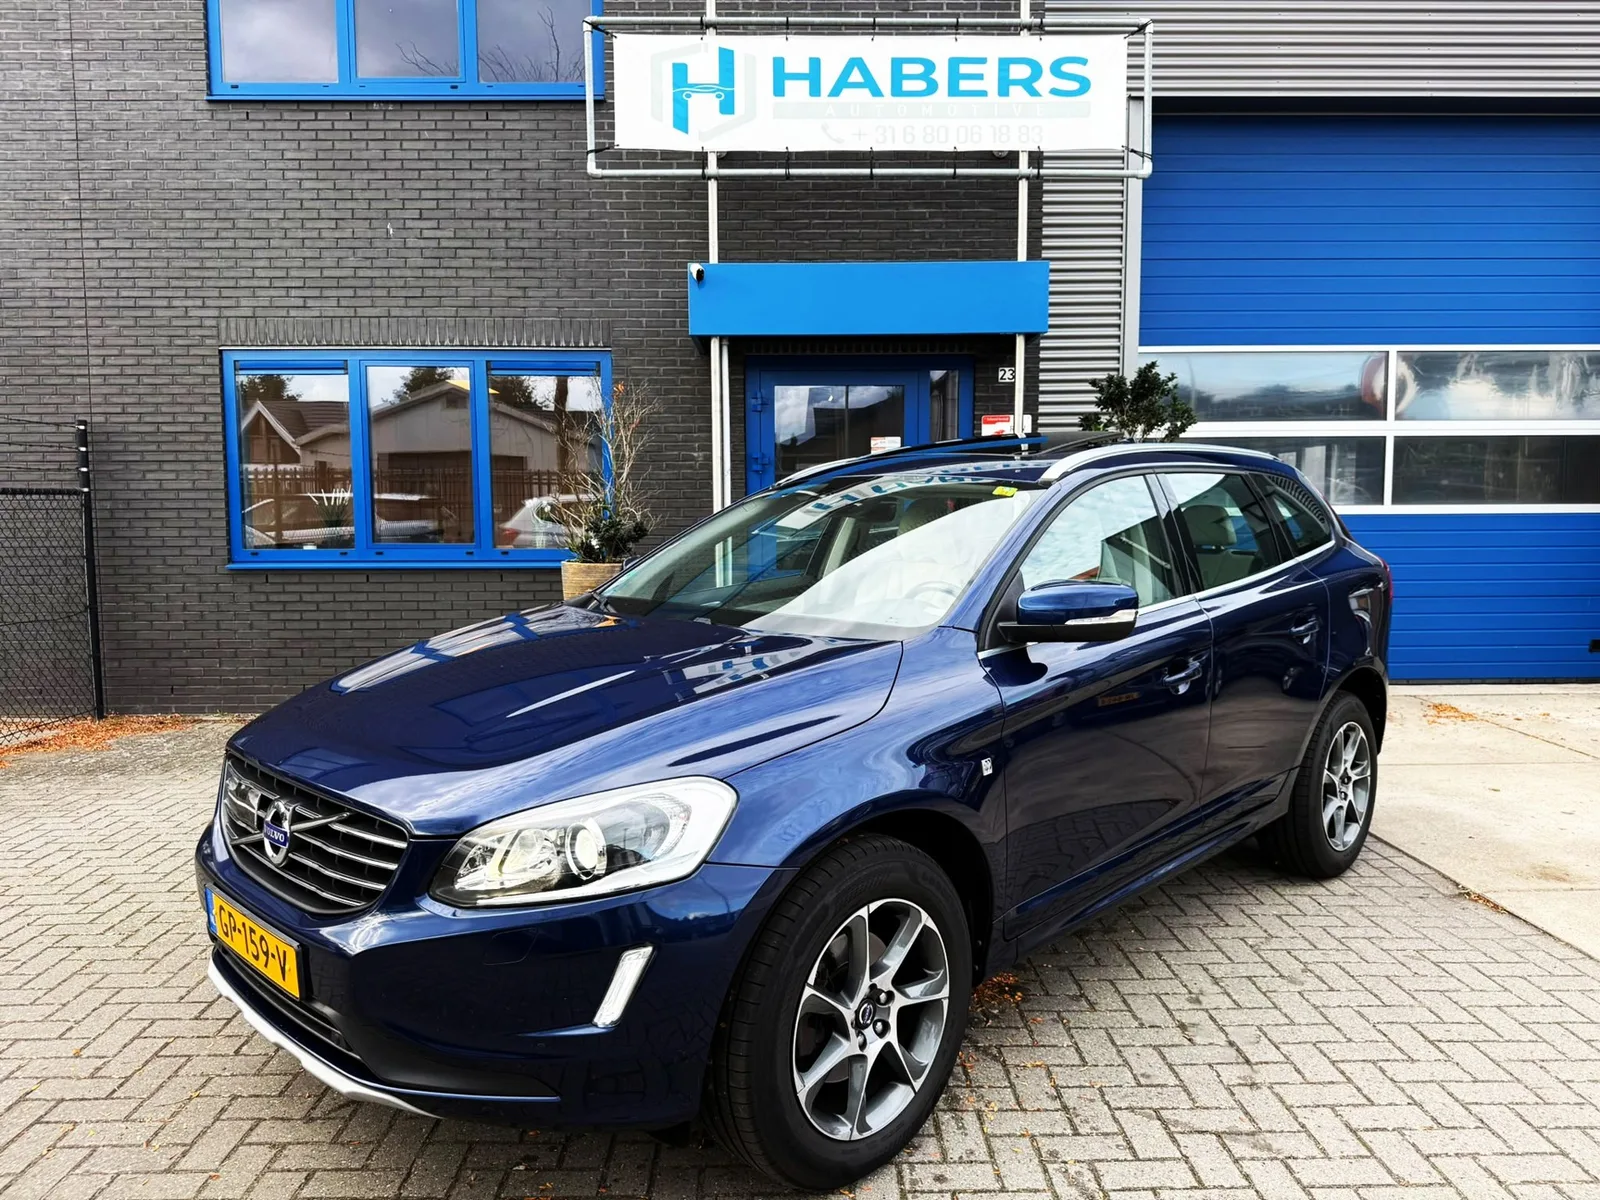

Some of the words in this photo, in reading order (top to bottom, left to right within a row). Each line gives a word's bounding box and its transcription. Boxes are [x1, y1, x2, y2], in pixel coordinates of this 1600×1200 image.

[772, 56, 1092, 97] HABERS
[824, 103, 1044, 117] AUTOMOTIVE
[922, 124, 949, 145] 80
[956, 124, 983, 145] 06
[988, 124, 1011, 145] 18
[1017, 124, 1044, 145] 83
[999, 368, 1016, 381] 23
[218, 904, 287, 982] GP-159-V
